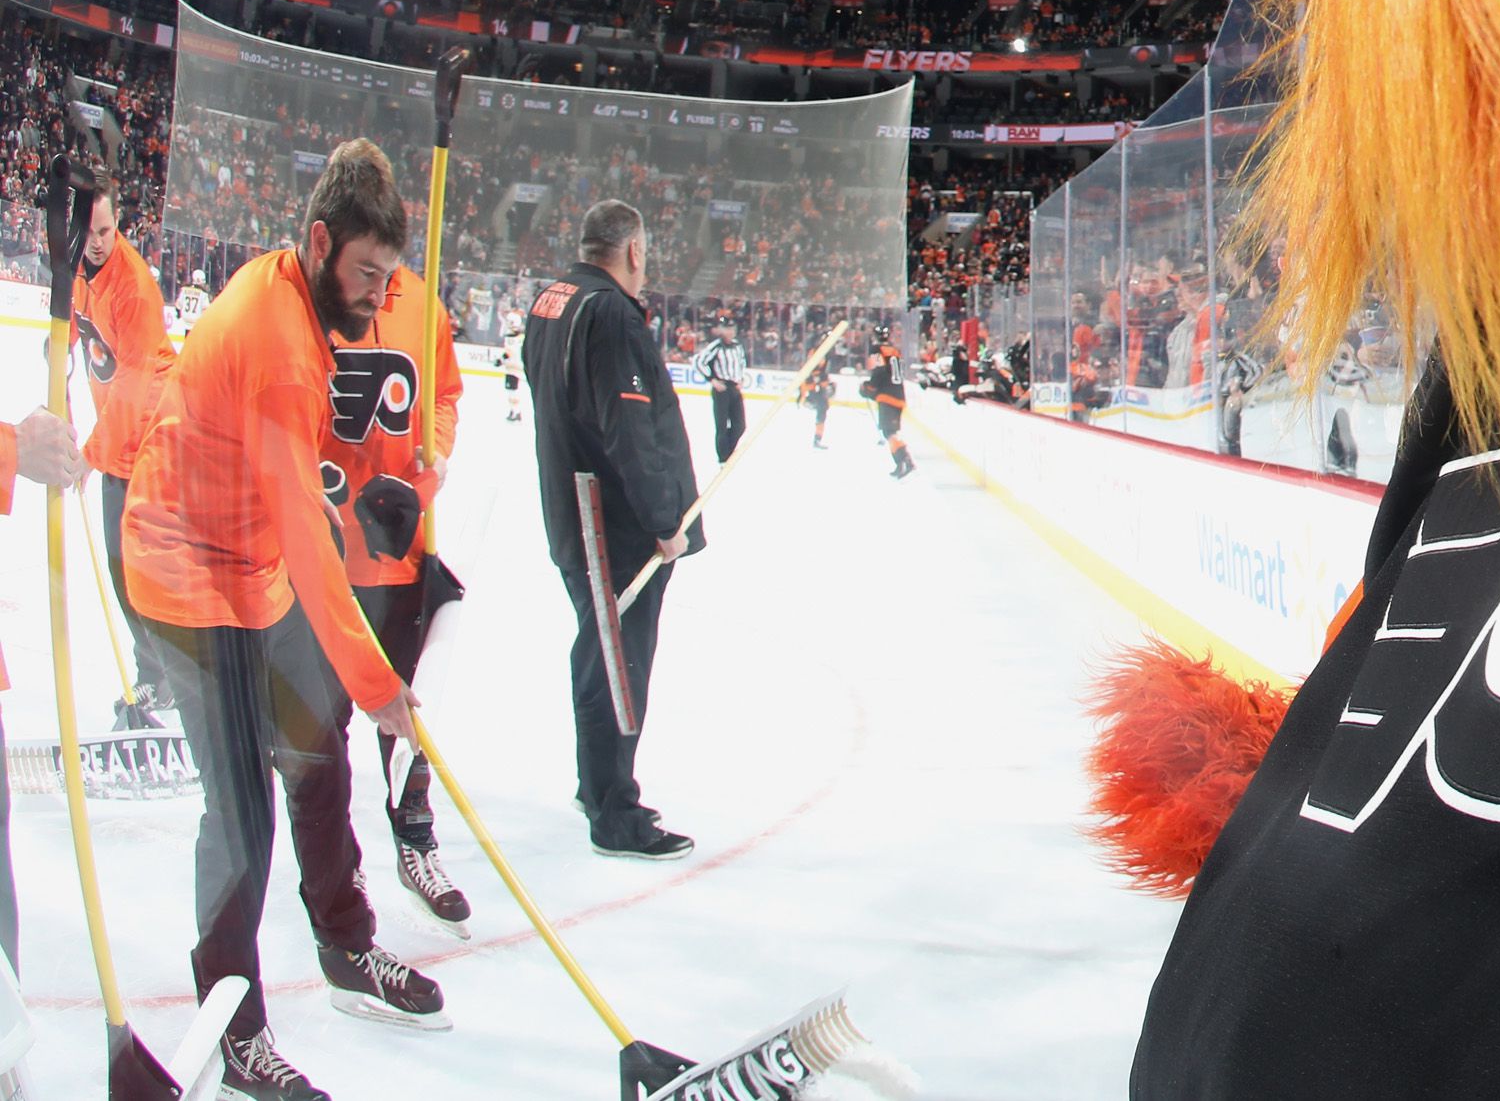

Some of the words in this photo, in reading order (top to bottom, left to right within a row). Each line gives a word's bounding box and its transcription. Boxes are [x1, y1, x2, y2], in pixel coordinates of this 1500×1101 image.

[119, 16, 135, 36] 14
[492, 18, 509, 36] 14
[862, 49, 973, 71] FLYERS
[558, 98, 569, 116] 2
[668, 108, 680, 125] 4
[686, 114, 716, 126] FLYERS
[876, 125, 932, 141] FLYERS
[1007, 127, 1041, 139] RAW
[184, 295, 200, 315] 37
[1193, 506, 1288, 619] Walmart
